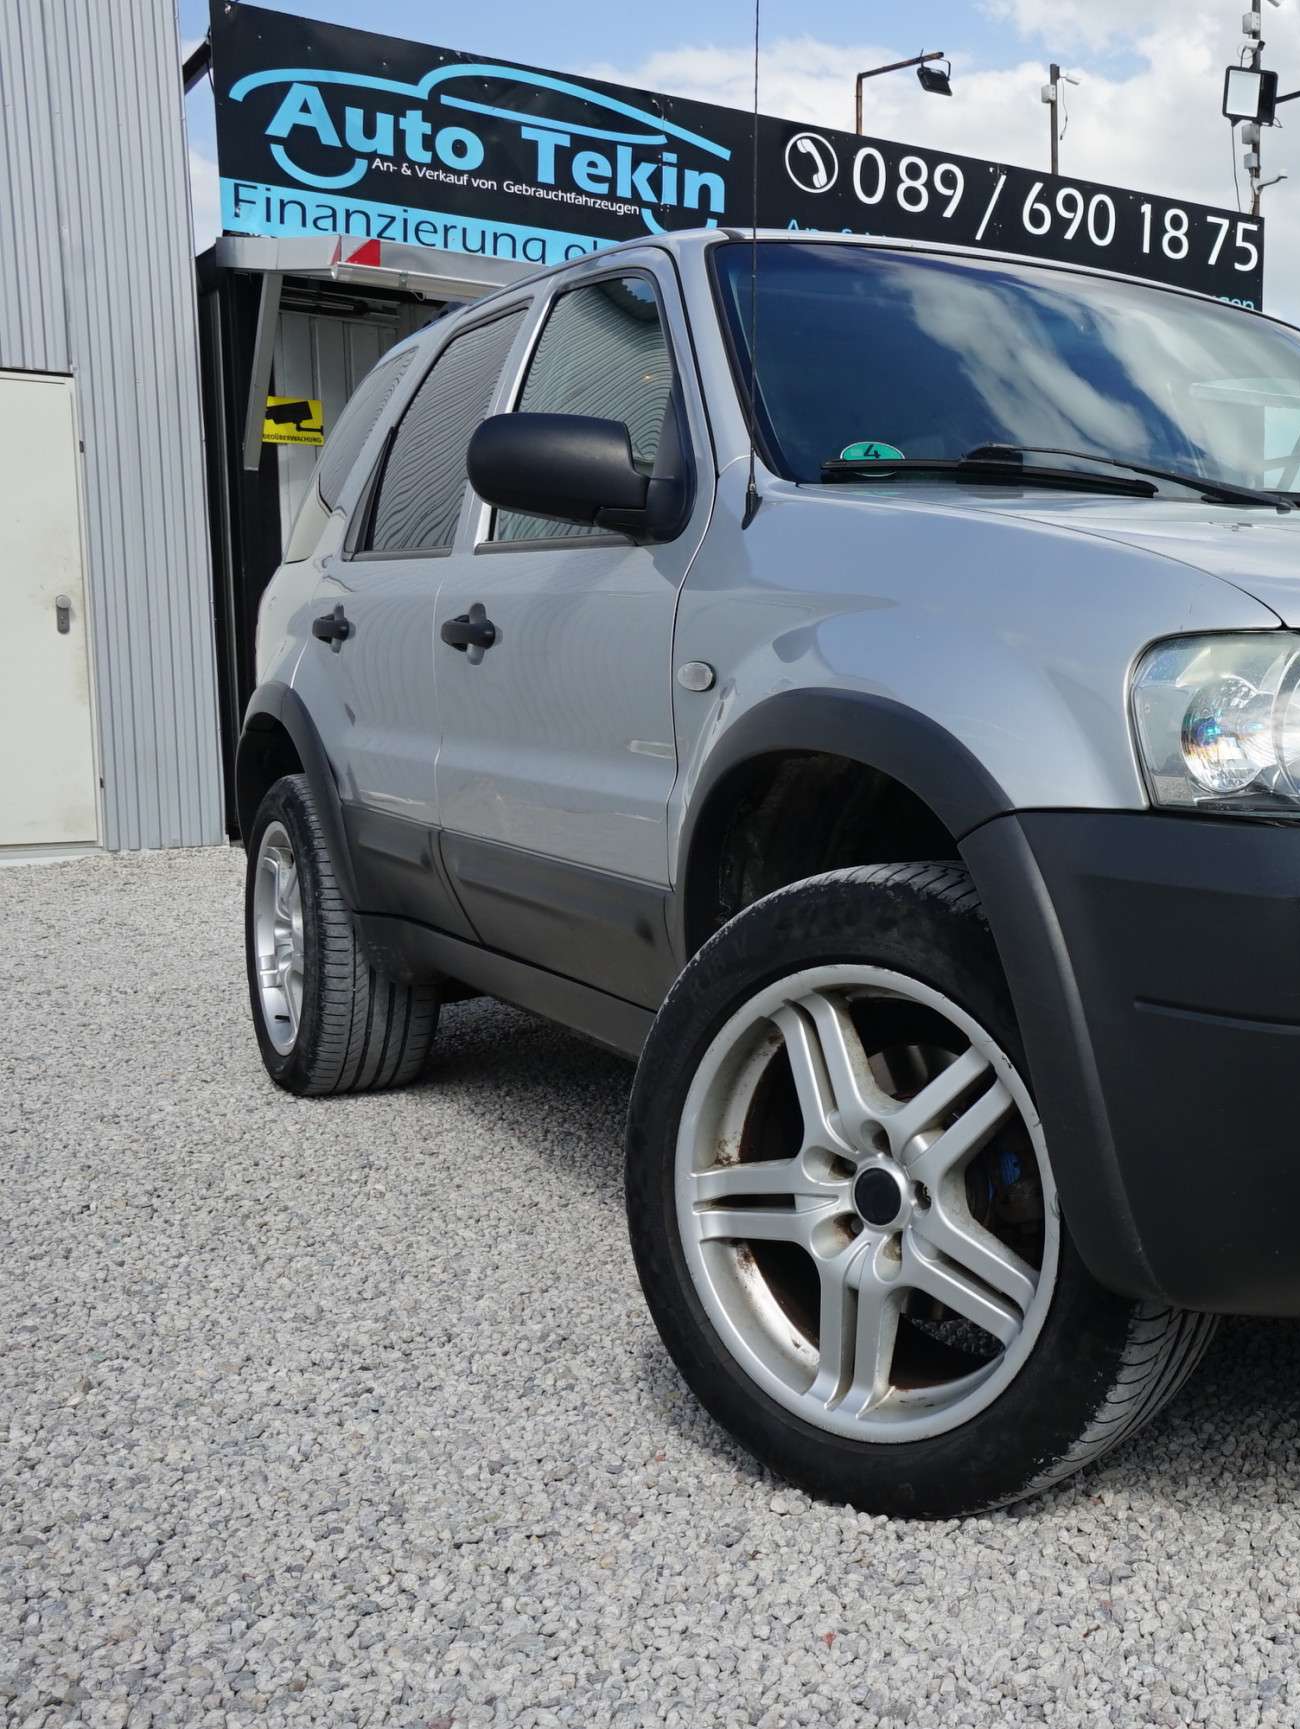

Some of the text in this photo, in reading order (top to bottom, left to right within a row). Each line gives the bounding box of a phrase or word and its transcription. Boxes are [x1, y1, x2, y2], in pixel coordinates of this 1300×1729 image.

[265, 82, 725, 213] Auto Tekin
[371, 158, 640, 215] An- & Verkauf von Gebrauchtfahrzeugen
[852, 146, 1259, 271] 089 / 690 18 75
[863, 443, 880, 459] 4
